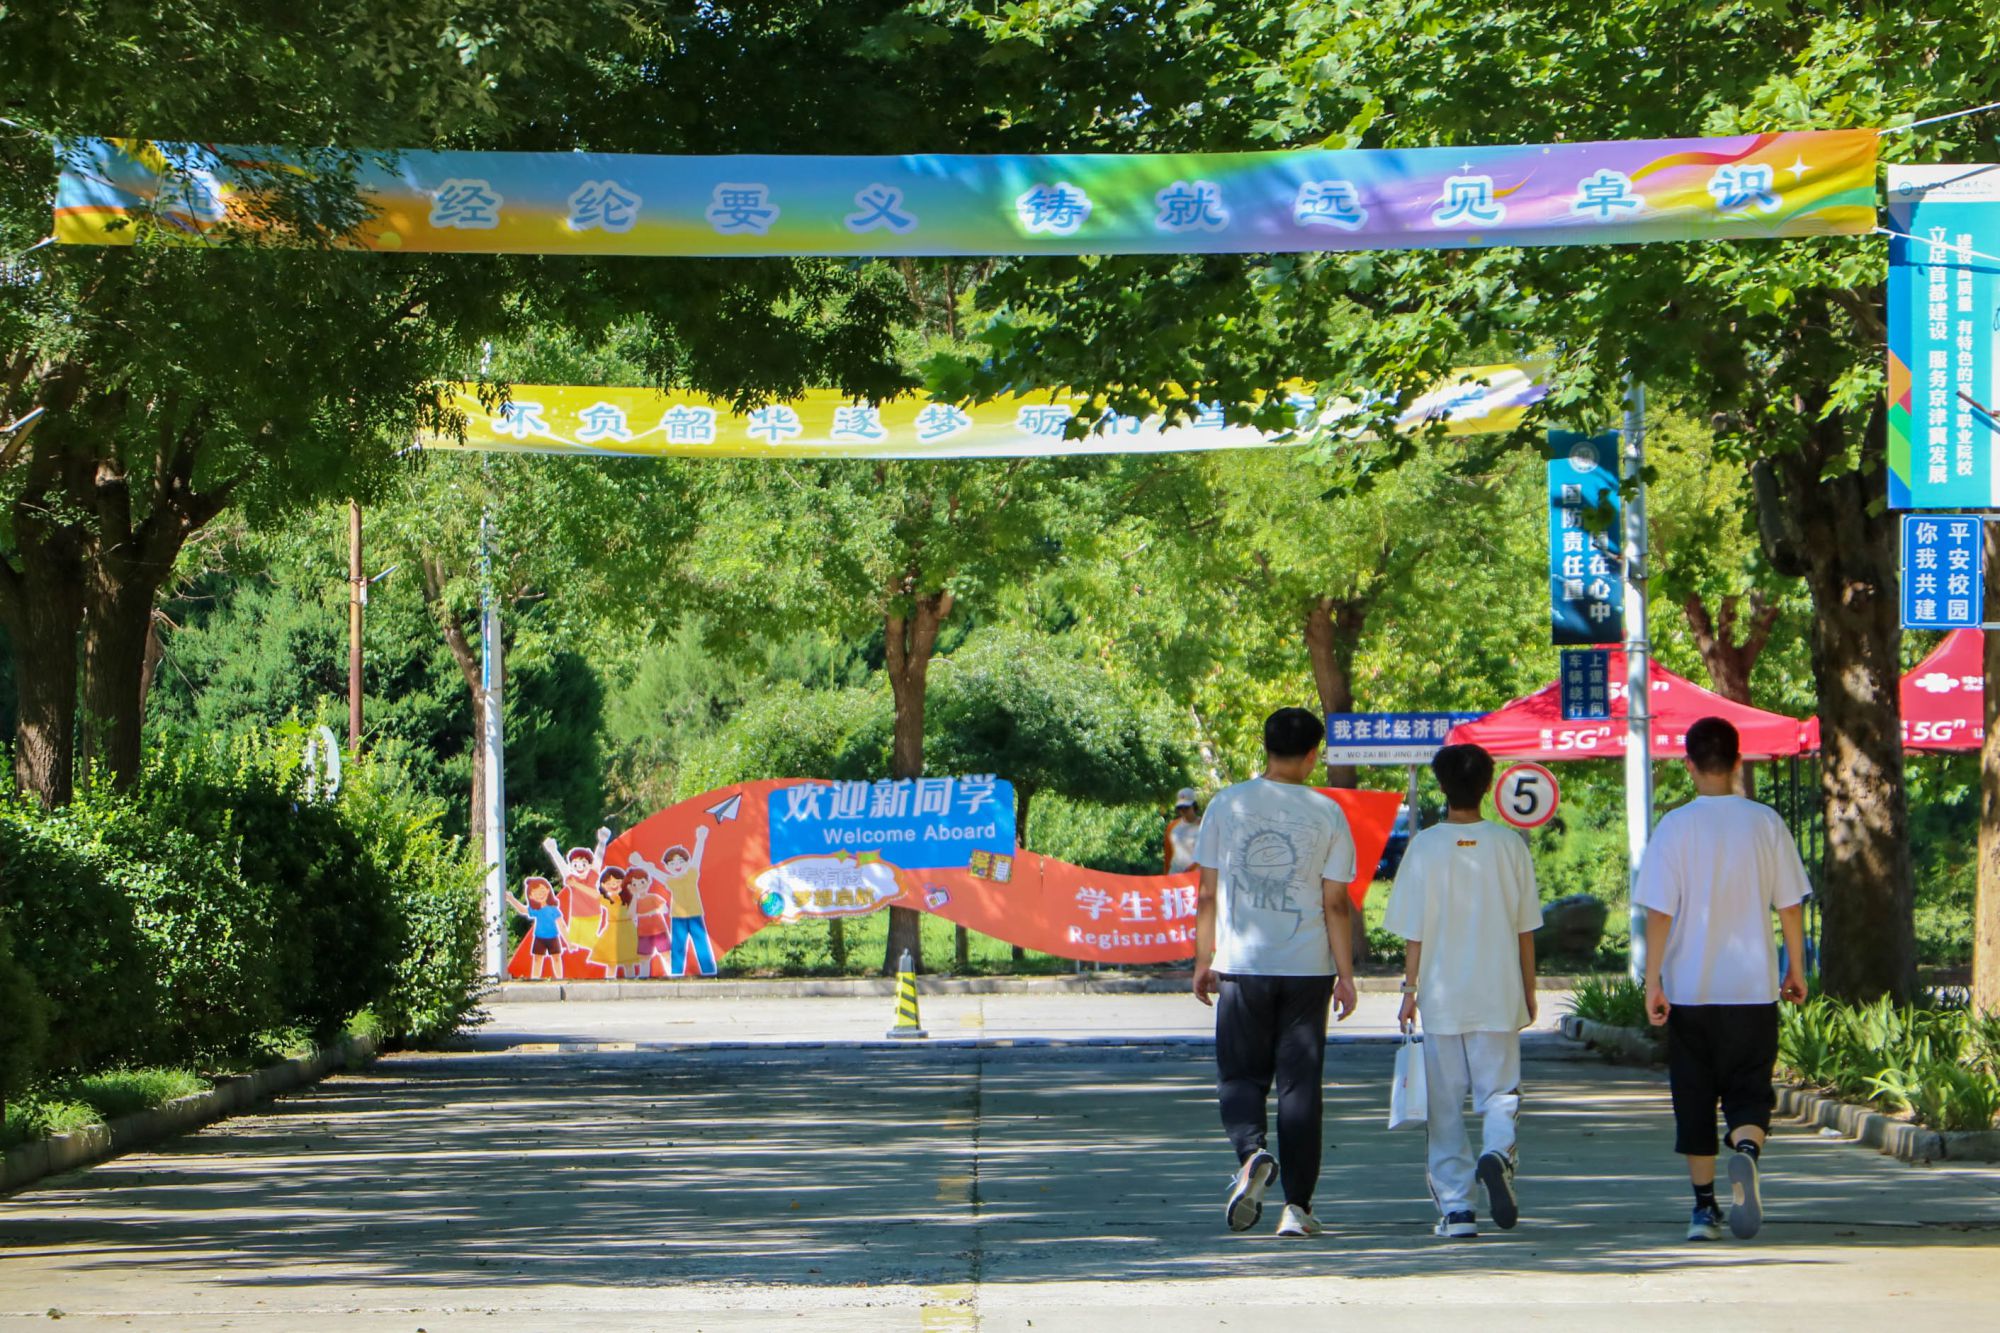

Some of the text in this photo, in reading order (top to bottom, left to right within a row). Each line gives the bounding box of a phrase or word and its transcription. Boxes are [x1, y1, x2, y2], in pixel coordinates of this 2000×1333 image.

[160, 163, 1782, 236] 通经纶要义铸就远见卓识
[1561, 484, 1584, 601] 国防责任重
[1588, 508, 1611, 623] 国在心中
[1915, 523, 1938, 620] 你我共建
[1947, 523, 1970, 621] 平安校园
[1334, 718, 1478, 739] 我在北经济很
[785, 775, 996, 820] 欢迎新同学
[1513, 777, 1539, 815] 5
[823, 822, 996, 845] Welcome Aboard
[1075, 885, 1197, 921] 学生报
